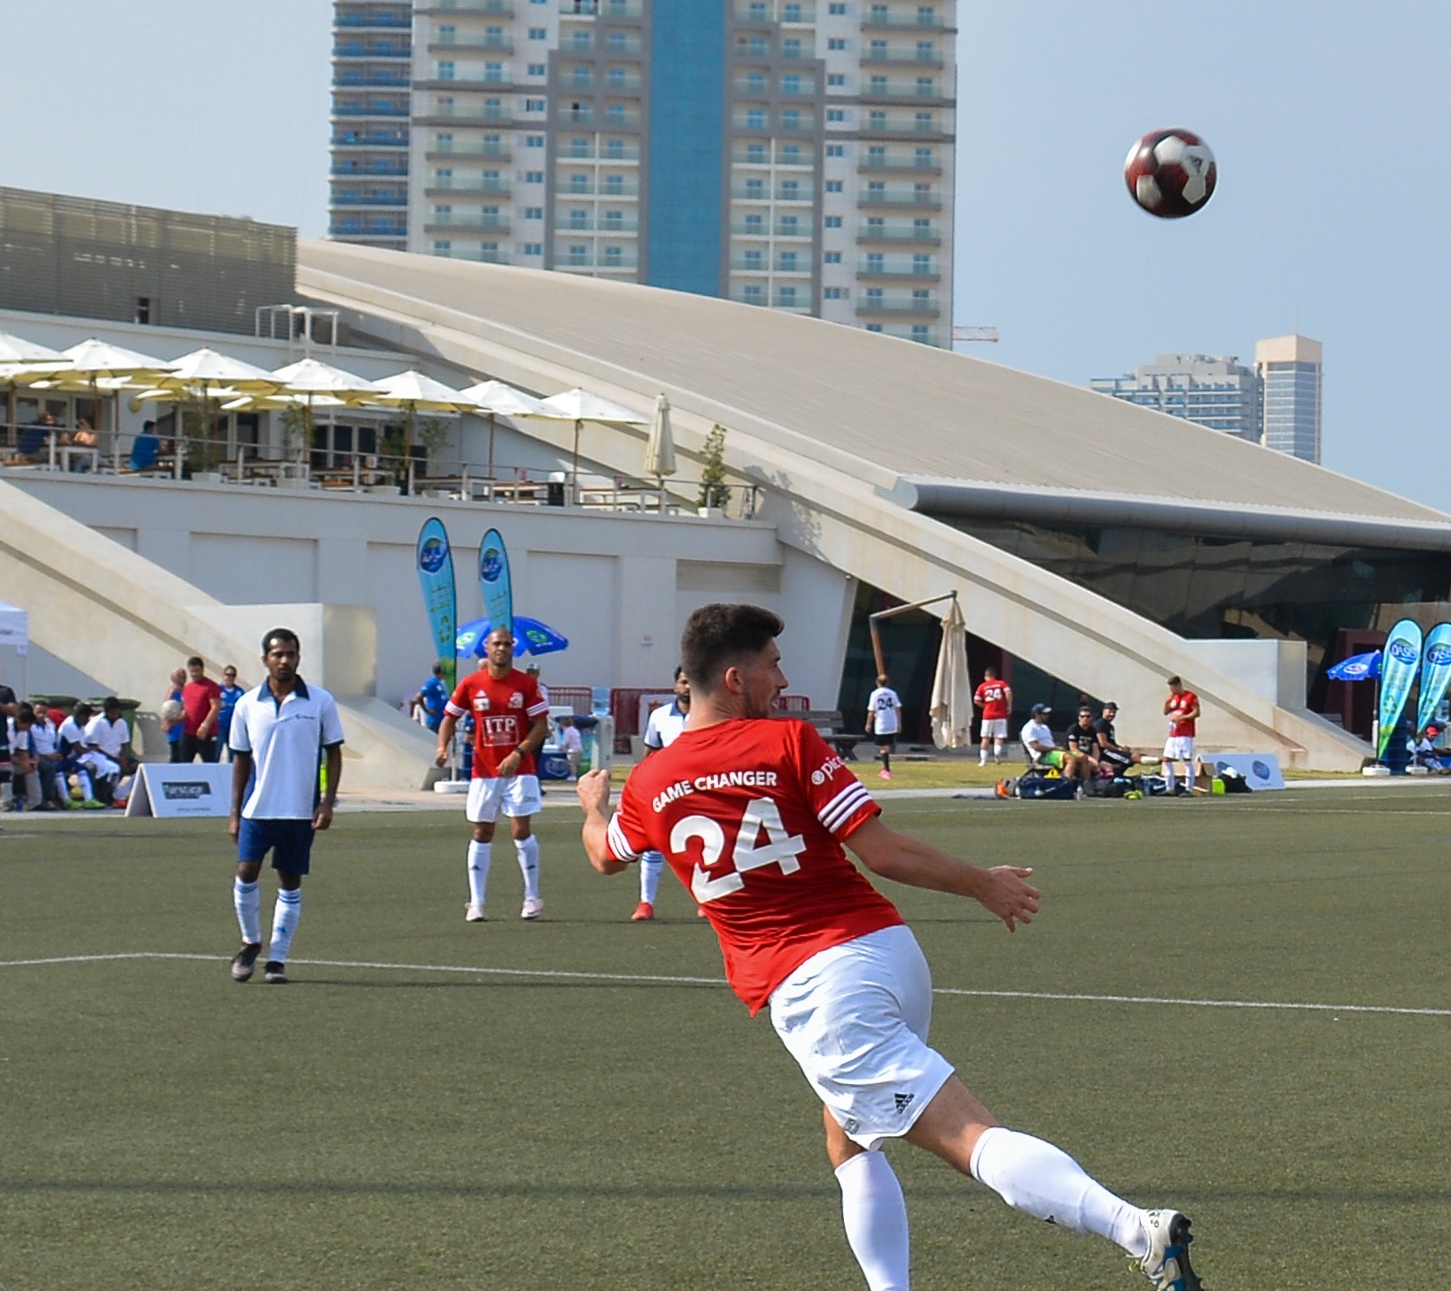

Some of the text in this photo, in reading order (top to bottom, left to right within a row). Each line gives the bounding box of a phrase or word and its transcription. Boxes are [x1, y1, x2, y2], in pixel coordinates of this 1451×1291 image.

[1391, 644, 1416, 659] OASIS
[985, 689, 1004, 702] 24
[877, 697, 895, 710] 24
[485, 718, 515, 734] ITP
[652, 771, 777, 813] GAME CHANGER
[670, 796, 807, 904] 24
